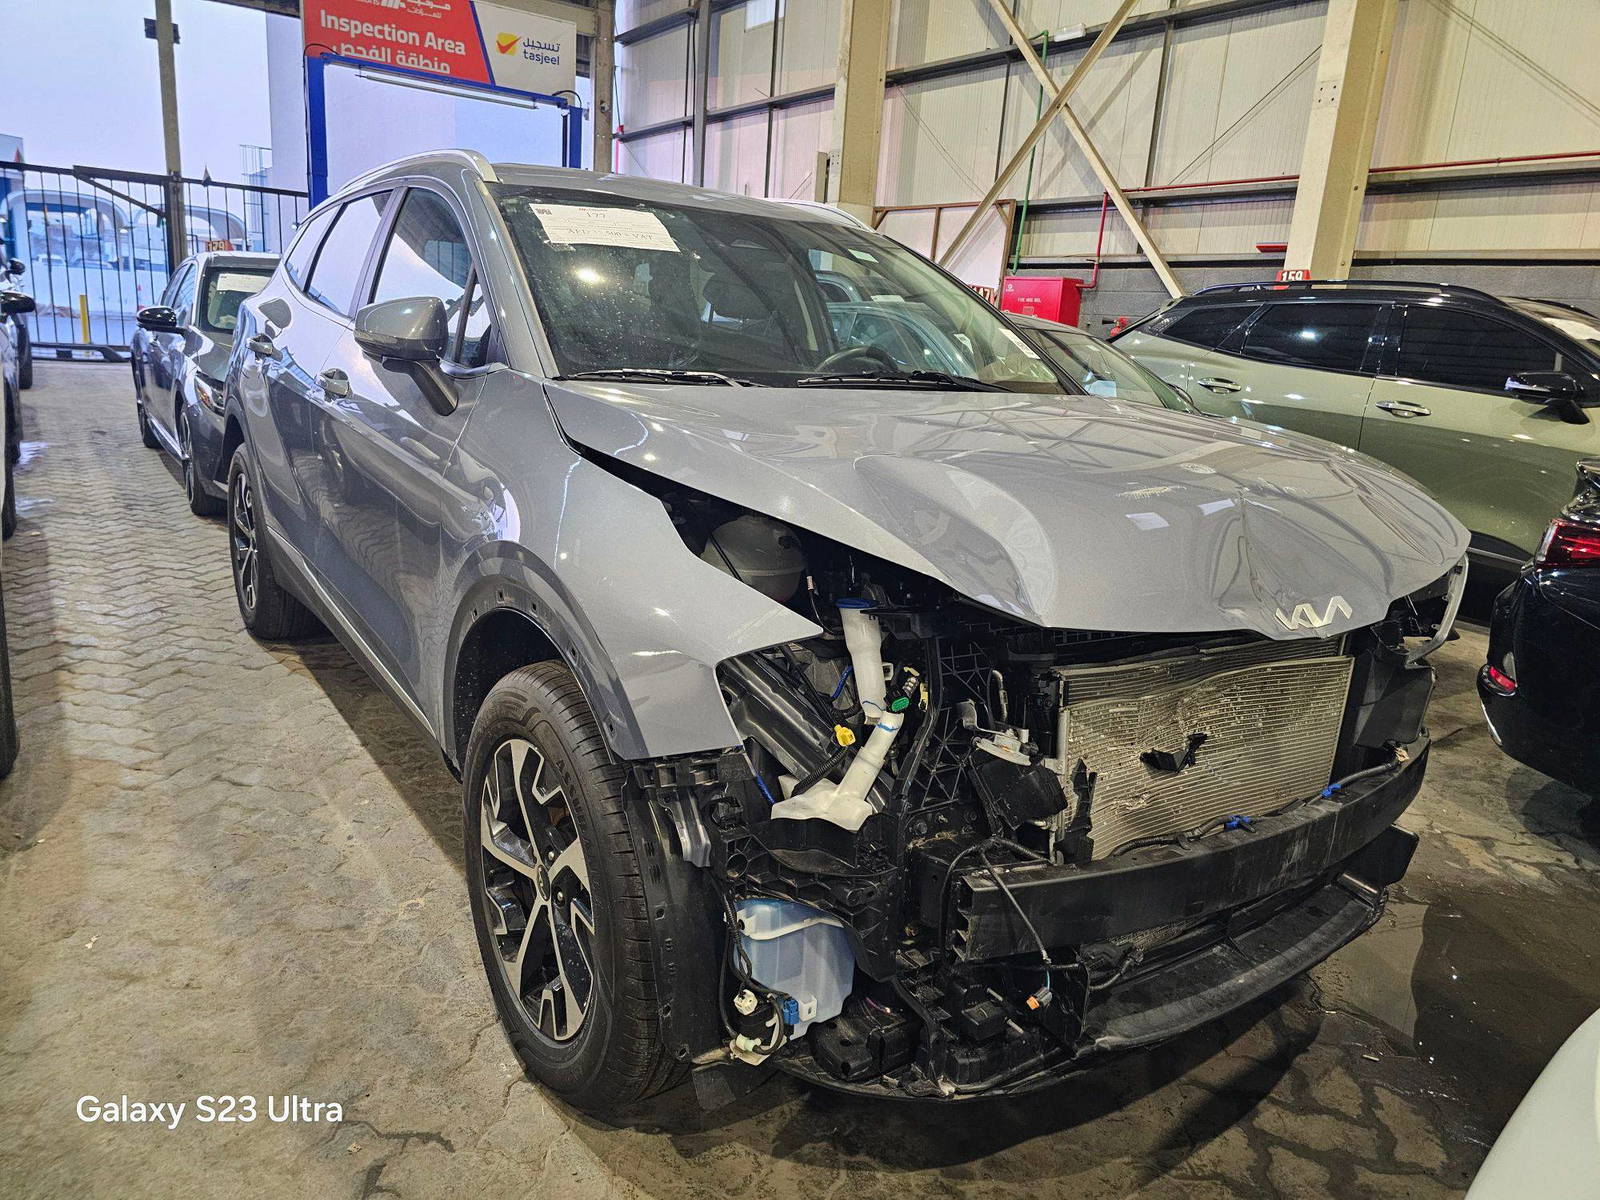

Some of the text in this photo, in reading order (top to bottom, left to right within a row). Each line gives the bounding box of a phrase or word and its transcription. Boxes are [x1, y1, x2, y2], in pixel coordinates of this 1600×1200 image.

[320, 9, 466, 56] Inspection Area
[522, 38, 560, 52] تسجيل
[523, 49, 560, 65] tasjeel
[332, 42, 450, 74] منطقة الفحص
